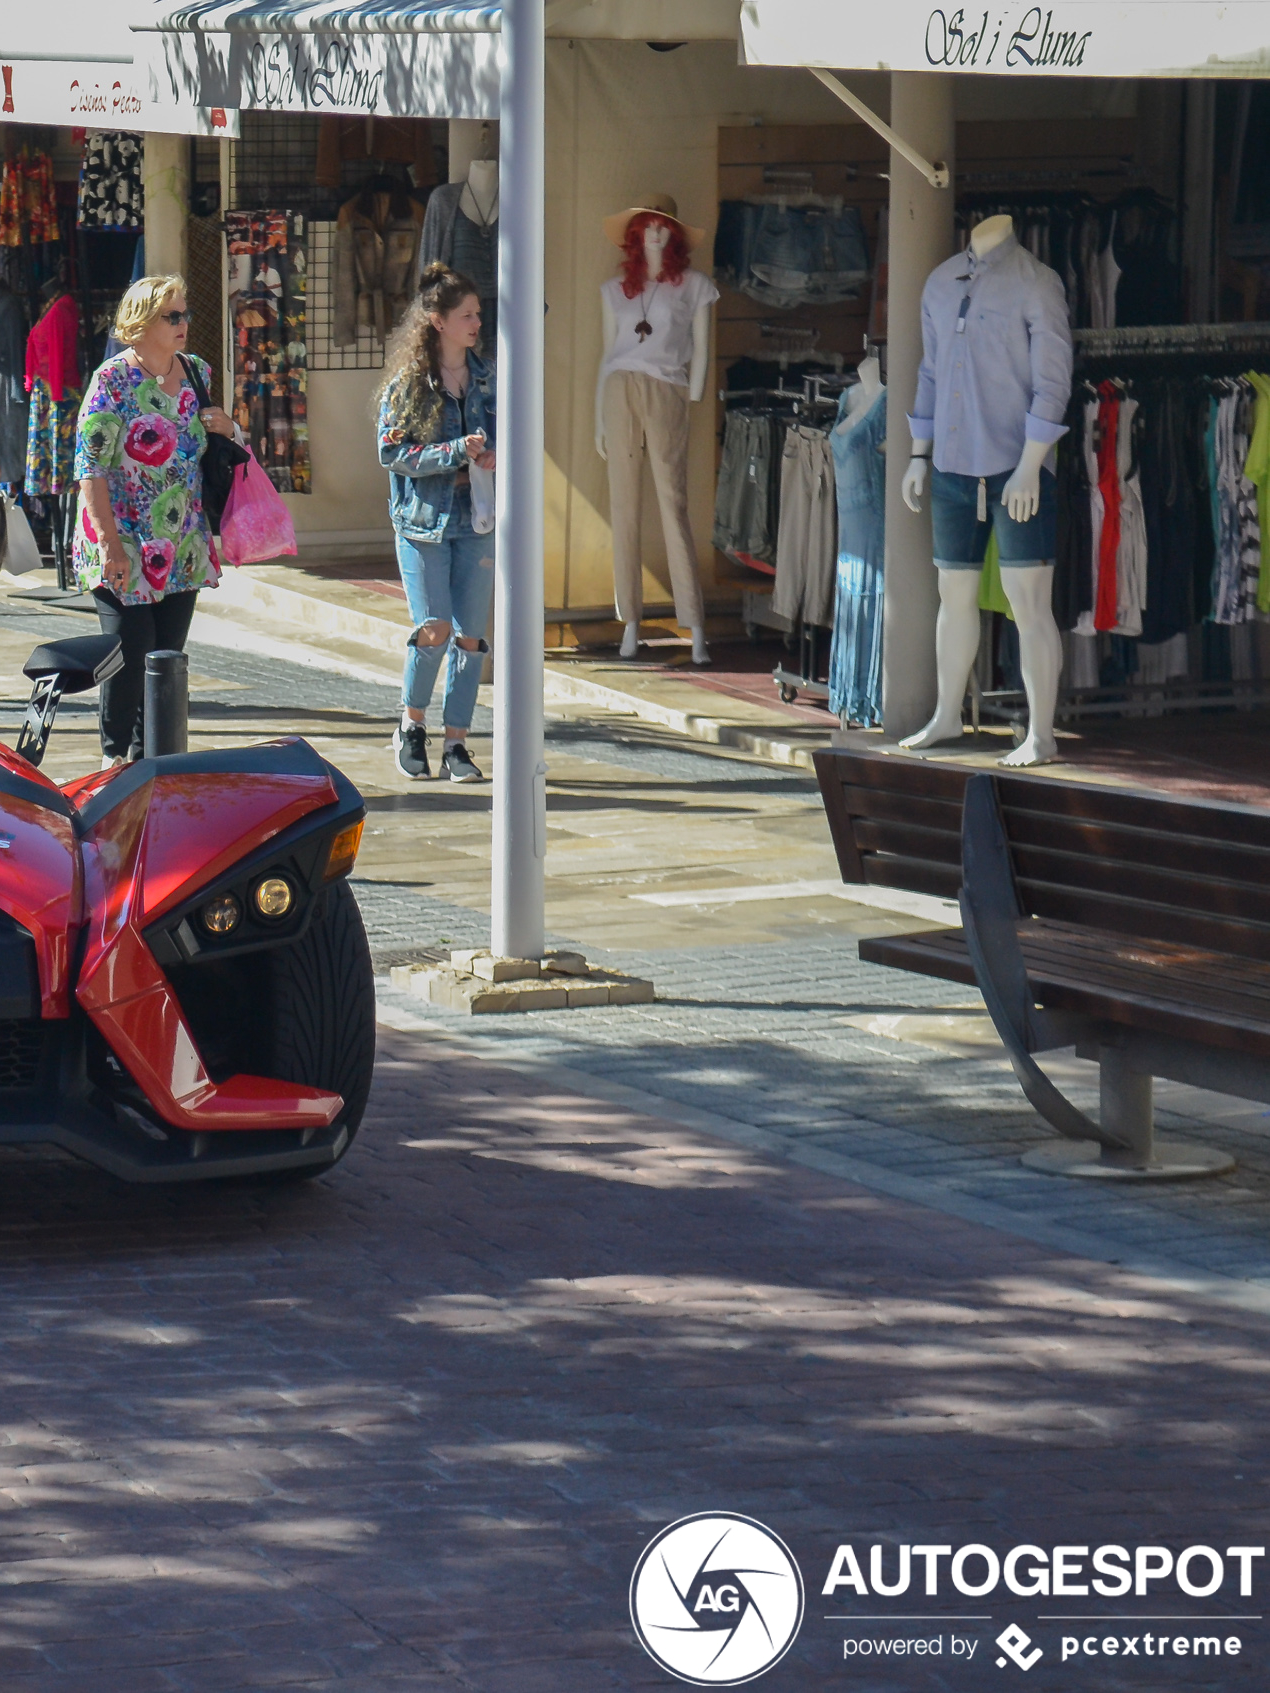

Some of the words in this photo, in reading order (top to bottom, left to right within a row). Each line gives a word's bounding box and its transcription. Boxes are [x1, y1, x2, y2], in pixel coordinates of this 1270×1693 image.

[925, 9, 988, 65] Sol
[986, 20, 1002, 65] i
[251, 41, 300, 104] Sol
